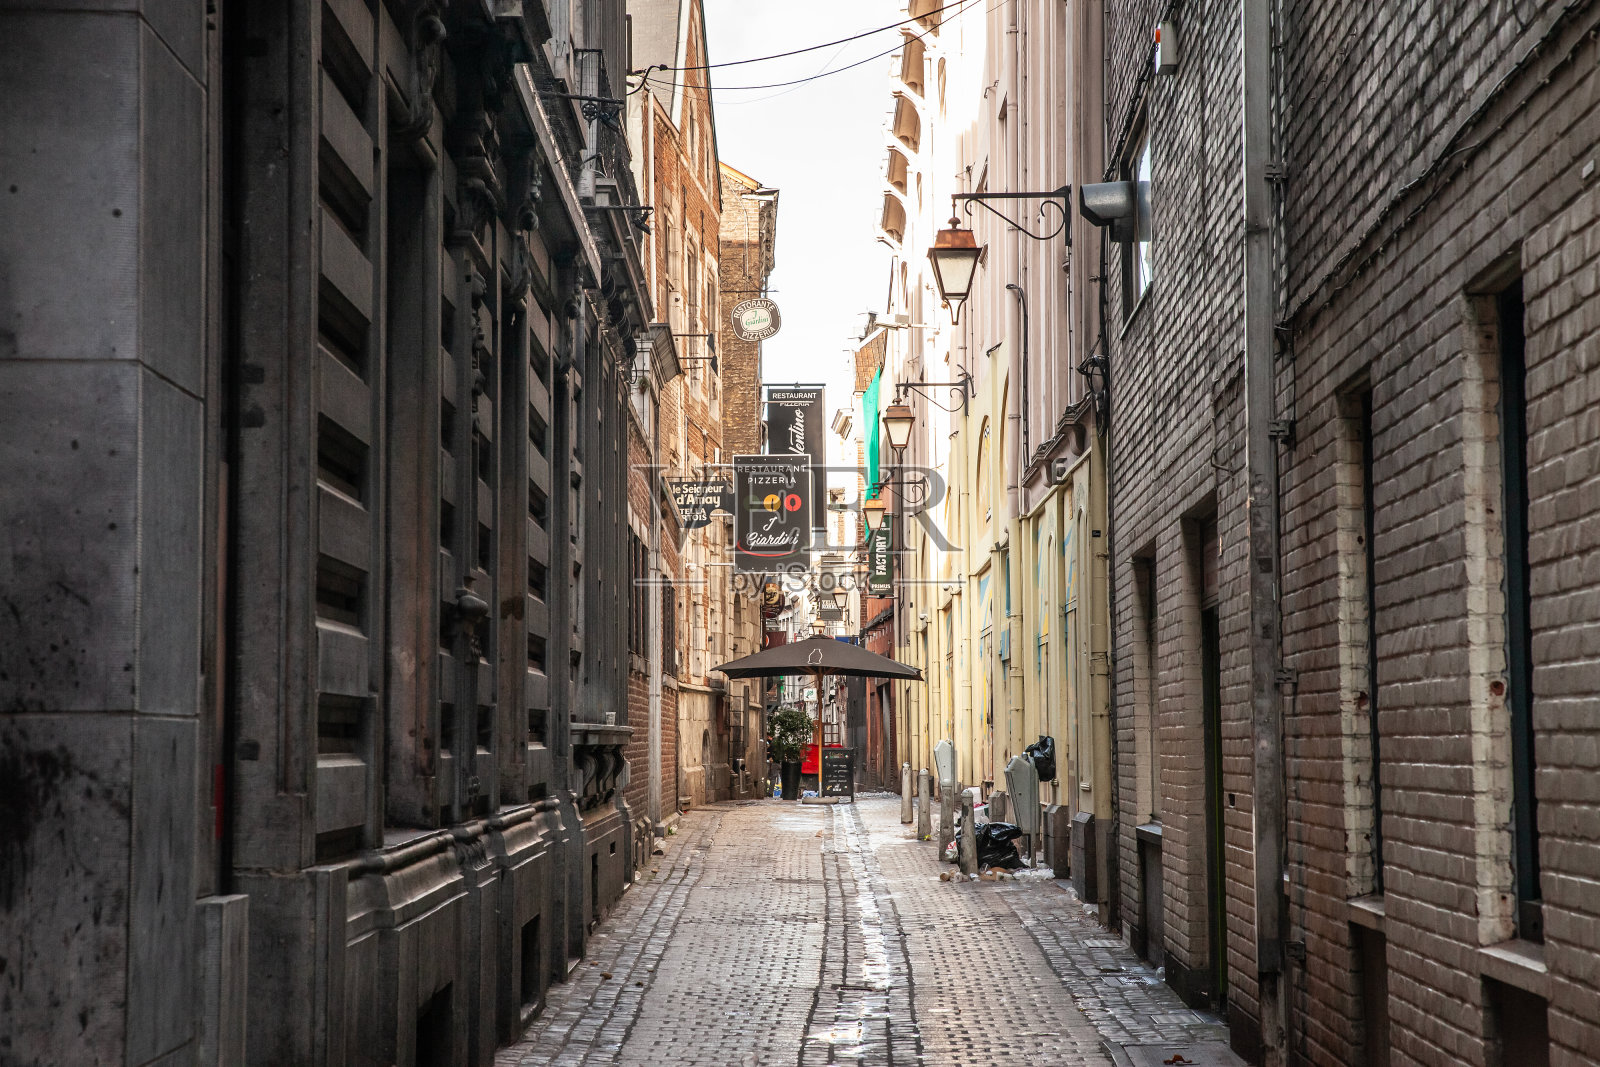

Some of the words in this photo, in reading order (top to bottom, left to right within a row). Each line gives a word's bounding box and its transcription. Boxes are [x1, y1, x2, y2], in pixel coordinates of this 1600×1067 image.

[733, 300, 776, 319] RISTORANTE
[741, 326, 776, 340] PIZZERIA
[788, 408, 805, 455] lentino
[737, 465, 807, 473] RESTAURANT
[747, 476, 797, 484] PIZZERIA
[672, 484, 681, 494] le
[682, 484, 724, 496] Seigneur
[746, 531, 800, 551] Giardini
[875, 535, 887, 576] FACTORY
